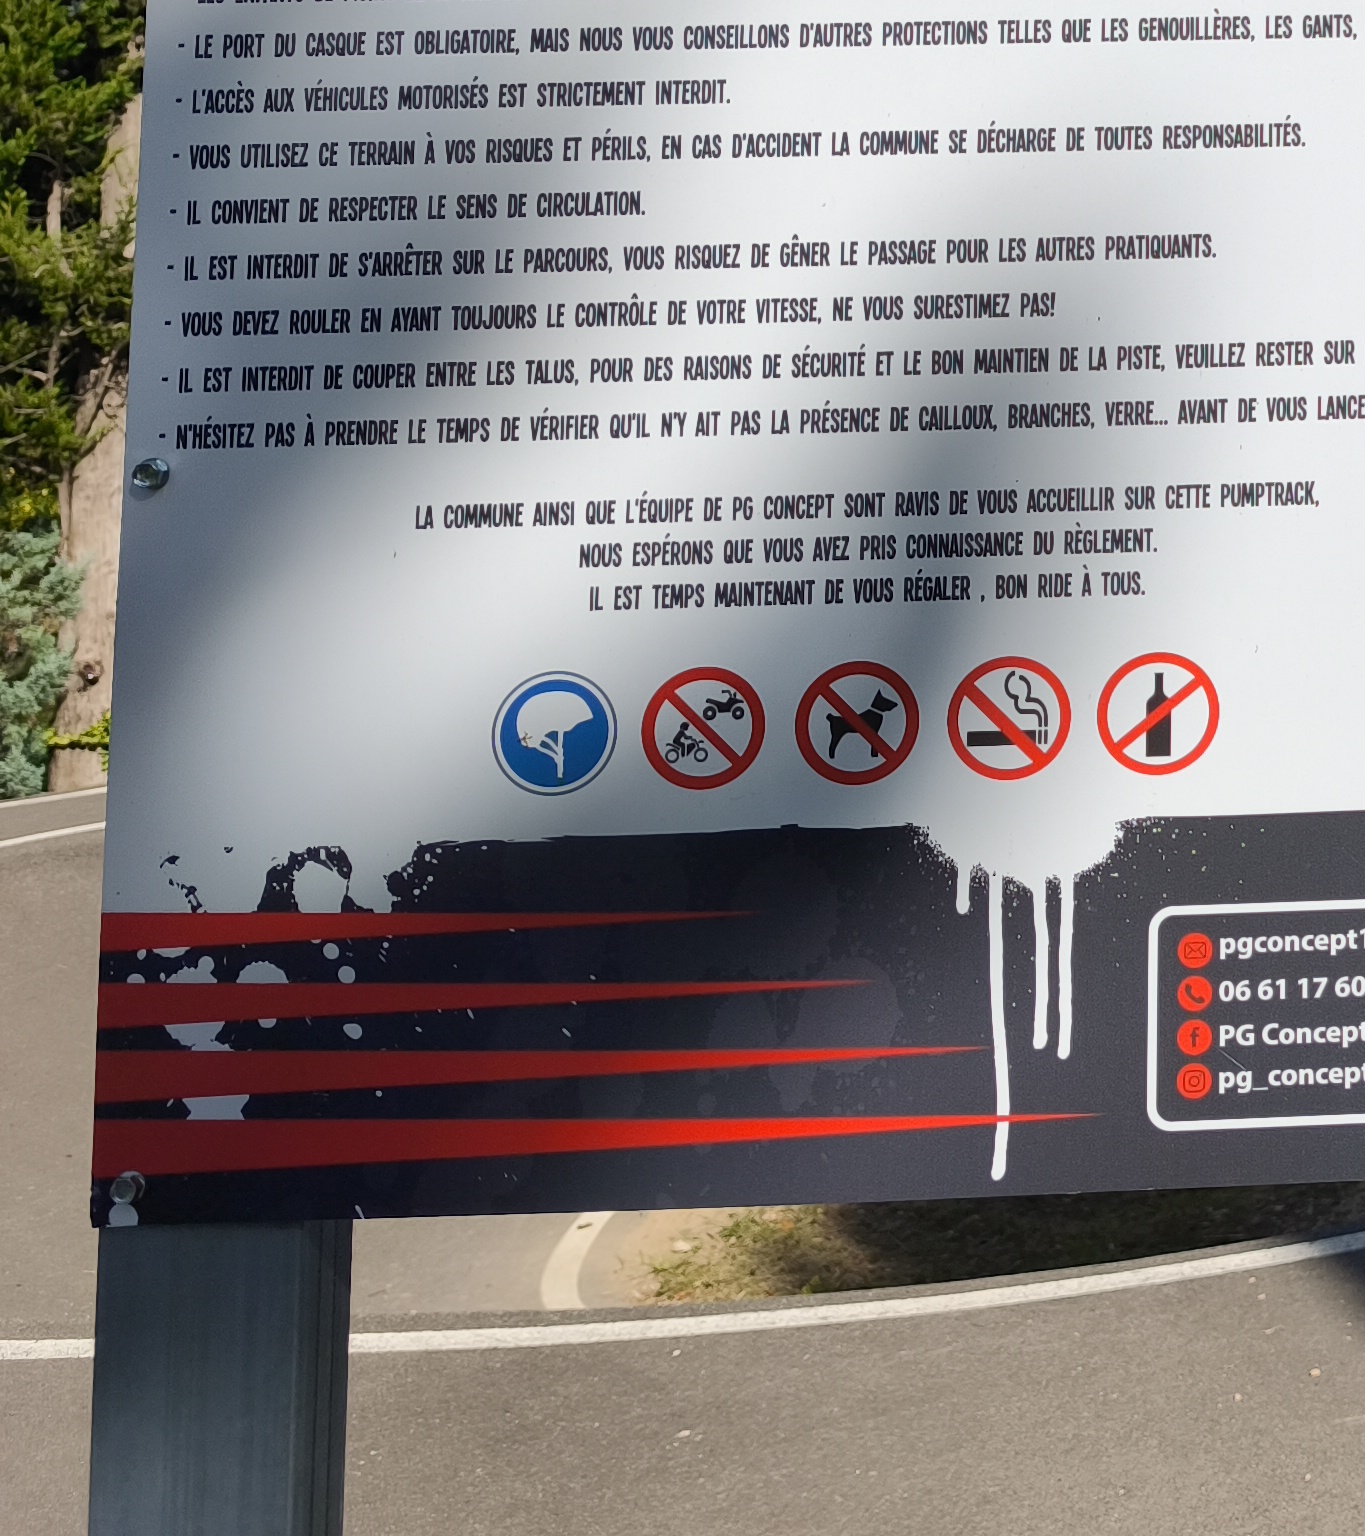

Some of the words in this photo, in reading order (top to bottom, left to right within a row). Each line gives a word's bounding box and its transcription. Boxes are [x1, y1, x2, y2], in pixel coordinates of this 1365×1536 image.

[194, 34, 214, 59] LE
[222, 33, 266, 59] PORT
[273, 32, 297, 58] DU
[305, 31, 367, 58] CASQUE
[375, 30, 405, 56] EST
[414, 28, 520, 56] OBLIGATOIRE,
[529, 27, 570, 53] MAIS
[579, 26, 623, 52] NOUS
[632, 25, 674, 52] VOUS
[683, 23, 790, 50] CONSEILLONS
[799, 22, 873, 48] D'AUTRES
[882, 20, 988, 47] PROTECTIONS
[997, 19, 1052, 45] TELLES
[1061, 18, 1092, 44] QUE
[1100, 17, 1129, 43] LES
[1138, 8, 1256, 43] GENOUILLÈRES,
[1265, 15, 1293, 40] LES
[1302, 14, 1358, 41] GANTS,
[191, 80, 255, 115] L'ACCÈS
[262, 87, 295, 114] AUX
[303, 78, 389, 113] VÉHICULES
[397, 75, 489, 111] MOTORISÉS
[498, 83, 528, 108] EST
[536, 80, 646, 108] STRICTEMENT
[655, 78, 731, 106] INTERDIT.
[186, 199, 202, 226] IL
[211, 198, 290, 225] CONVIENT
[298, 197, 320, 223] DE
[328, 195, 418, 223] RESPECTER
[427, 194, 447, 220] LE
[455, 193, 498, 220] SENS
[506, 193, 528, 219] DE
[536, 190, 646, 218] CIRCULATION.
[175, 415, 255, 450] N'HÉSITEZ
[264, 421, 296, 448] PAS
[303, 412, 315, 447] À
[324, 419, 399, 447] PRENDRE
[407, 418, 427, 445] LE
[436, 417, 491, 444] TEMPS
[500, 416, 521, 442] DE
[529, 407, 600, 442] VÉRIFIER
[609, 412, 651, 439] QU'IL
[660, 411, 688, 438] N'Y
[694, 411, 721, 438] AIT
[730, 410, 761, 436] PAS
[770, 409, 790, 435] LA
[799, 399, 881, 434] PRÉSENCE
[889, 406, 910, 432] DE
[918, 404, 998, 433] CAILLOUX,
[1007, 401, 1095, 430] BRANCHES,
[1177, 398, 1229, 425] AVANT
[1237, 397, 1257, 423] DE
[1265, 396, 1308, 423] VOUS
[415, 504, 434, 530] LA
[443, 502, 525, 529] COMMUNE
[532, 500, 575, 527] AINSI
[585, 499, 617, 526] QUE
[625, 490, 694, 524] L'ÉQUIPE
[703, 496, 723, 522] DE
[732, 496, 754, 521] PG
[763, 493, 835, 521] CONCEPT
[843, 492, 886, 519] SONT
[894, 490, 940, 517] RAVIS
[948, 489, 969, 516] DE
[976, 488, 1018, 515] VOUS
[1026, 486, 1115, 514] ACCUEILLIR
[1124, 485, 1156, 511] SUR
[1165, 483, 1211, 510] CETTE
[1220, 480, 1320, 508] PUMPTRACK,
[578, 542, 623, 569] NOUS
[632, 532, 714, 567] ESPÉRONS
[723, 538, 754, 565] QUE
[762, 537, 804, 564] VOUS
[812, 535, 850, 562] AVEZ
[859, 534, 897, 561] PRIS
[905, 531, 1024, 560] CONNAISSANCE
[1033, 530, 1055, 556] DU
[1063, 521, 1158, 555] RÈGLEMENT.
[589, 586, 604, 612] IL
[613, 584, 643, 611] EST
[651, 583, 705, 610] TEMPS
[713, 579, 816, 608] MAINTENANT
[824, 578, 845, 605] DE
[852, 577, 894, 604] VOUS
[903, 568, 971, 603] RÉGALER
[995, 573, 1028, 600] BON
[1037, 572, 1073, 599] RIDE
[1081, 564, 1092, 598] À
[1100, 570, 1146, 597] TOUS.
[1218, 979, 1252, 1002] 06
[1257, 978, 1286, 1001] 61
[1297, 976, 1329, 999] 17
[1219, 1023, 1256, 1048] PG
